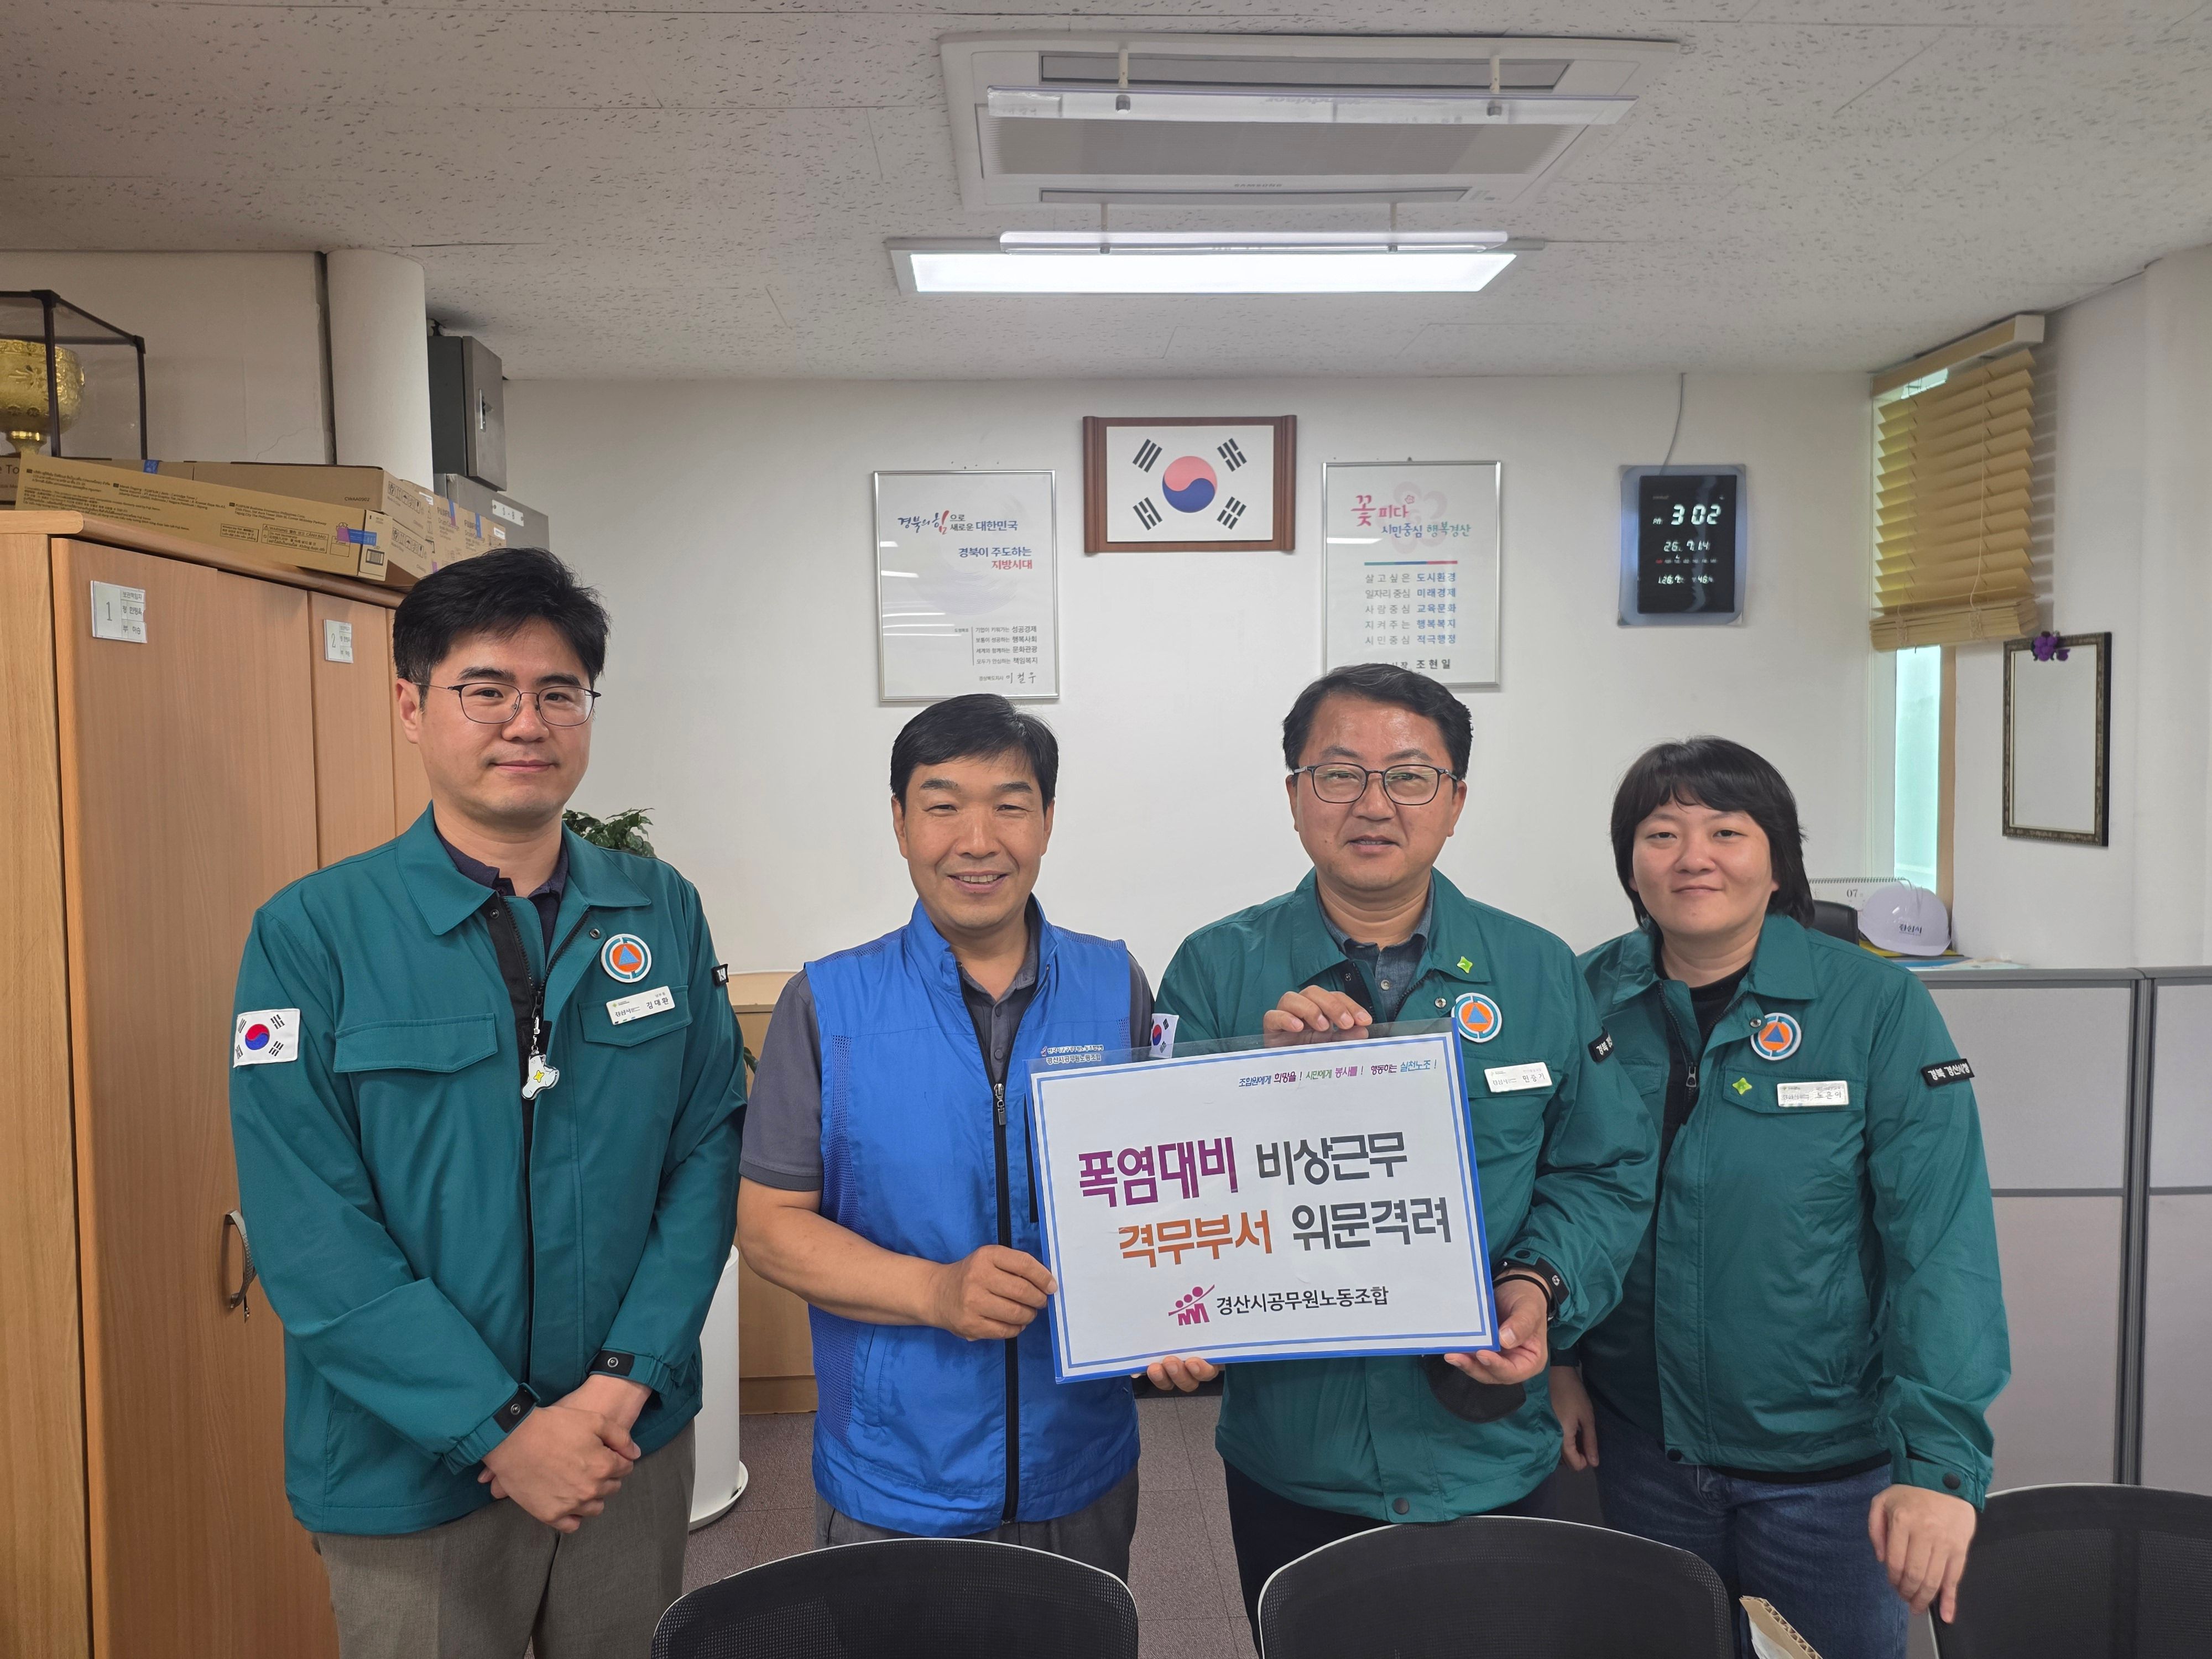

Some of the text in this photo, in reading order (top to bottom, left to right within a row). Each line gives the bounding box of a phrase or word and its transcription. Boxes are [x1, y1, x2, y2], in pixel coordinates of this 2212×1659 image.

[1350, 495, 1410, 526] 꽃 피다
[898, 516, 931, 533] 경북의
[950, 520, 1018, 531] 새로운 대한민국
[1381, 521, 1471, 538] 시민중심 행복경산
[958, 546, 1032, 558] 경북이 주도하는
[991, 559, 1032, 570] 지방시대
[1416, 572, 1456, 582] 도시환경
[1417, 588, 1456, 598] 미래경제
[1417, 603, 1456, 613] 교육문화
[1416, 619, 1456, 629] 행복복지
[1417, 634, 1456, 644] 적극행정
[1846, 888, 1858, 898] 07
[1239, 1076, 1271, 1087] 조합원에게
[1274, 1072, 1296, 1083] 희망을
[1306, 1070, 1332, 1080] 시민에게
[1335, 1066, 1358, 1078] 봉사를
[1371, 1064, 1397, 1074] 행동하는
[1400, 1060, 1431, 1072] 실천노조
[1928, 1068, 1946, 1081] 경북
[1079, 1132, 1407, 1207] 폭염대비 비상근무
[1119, 1197, 1451, 1267] 격무부서 위문격려
[1217, 1286, 1389, 1315] 경산시공무원노동조합
